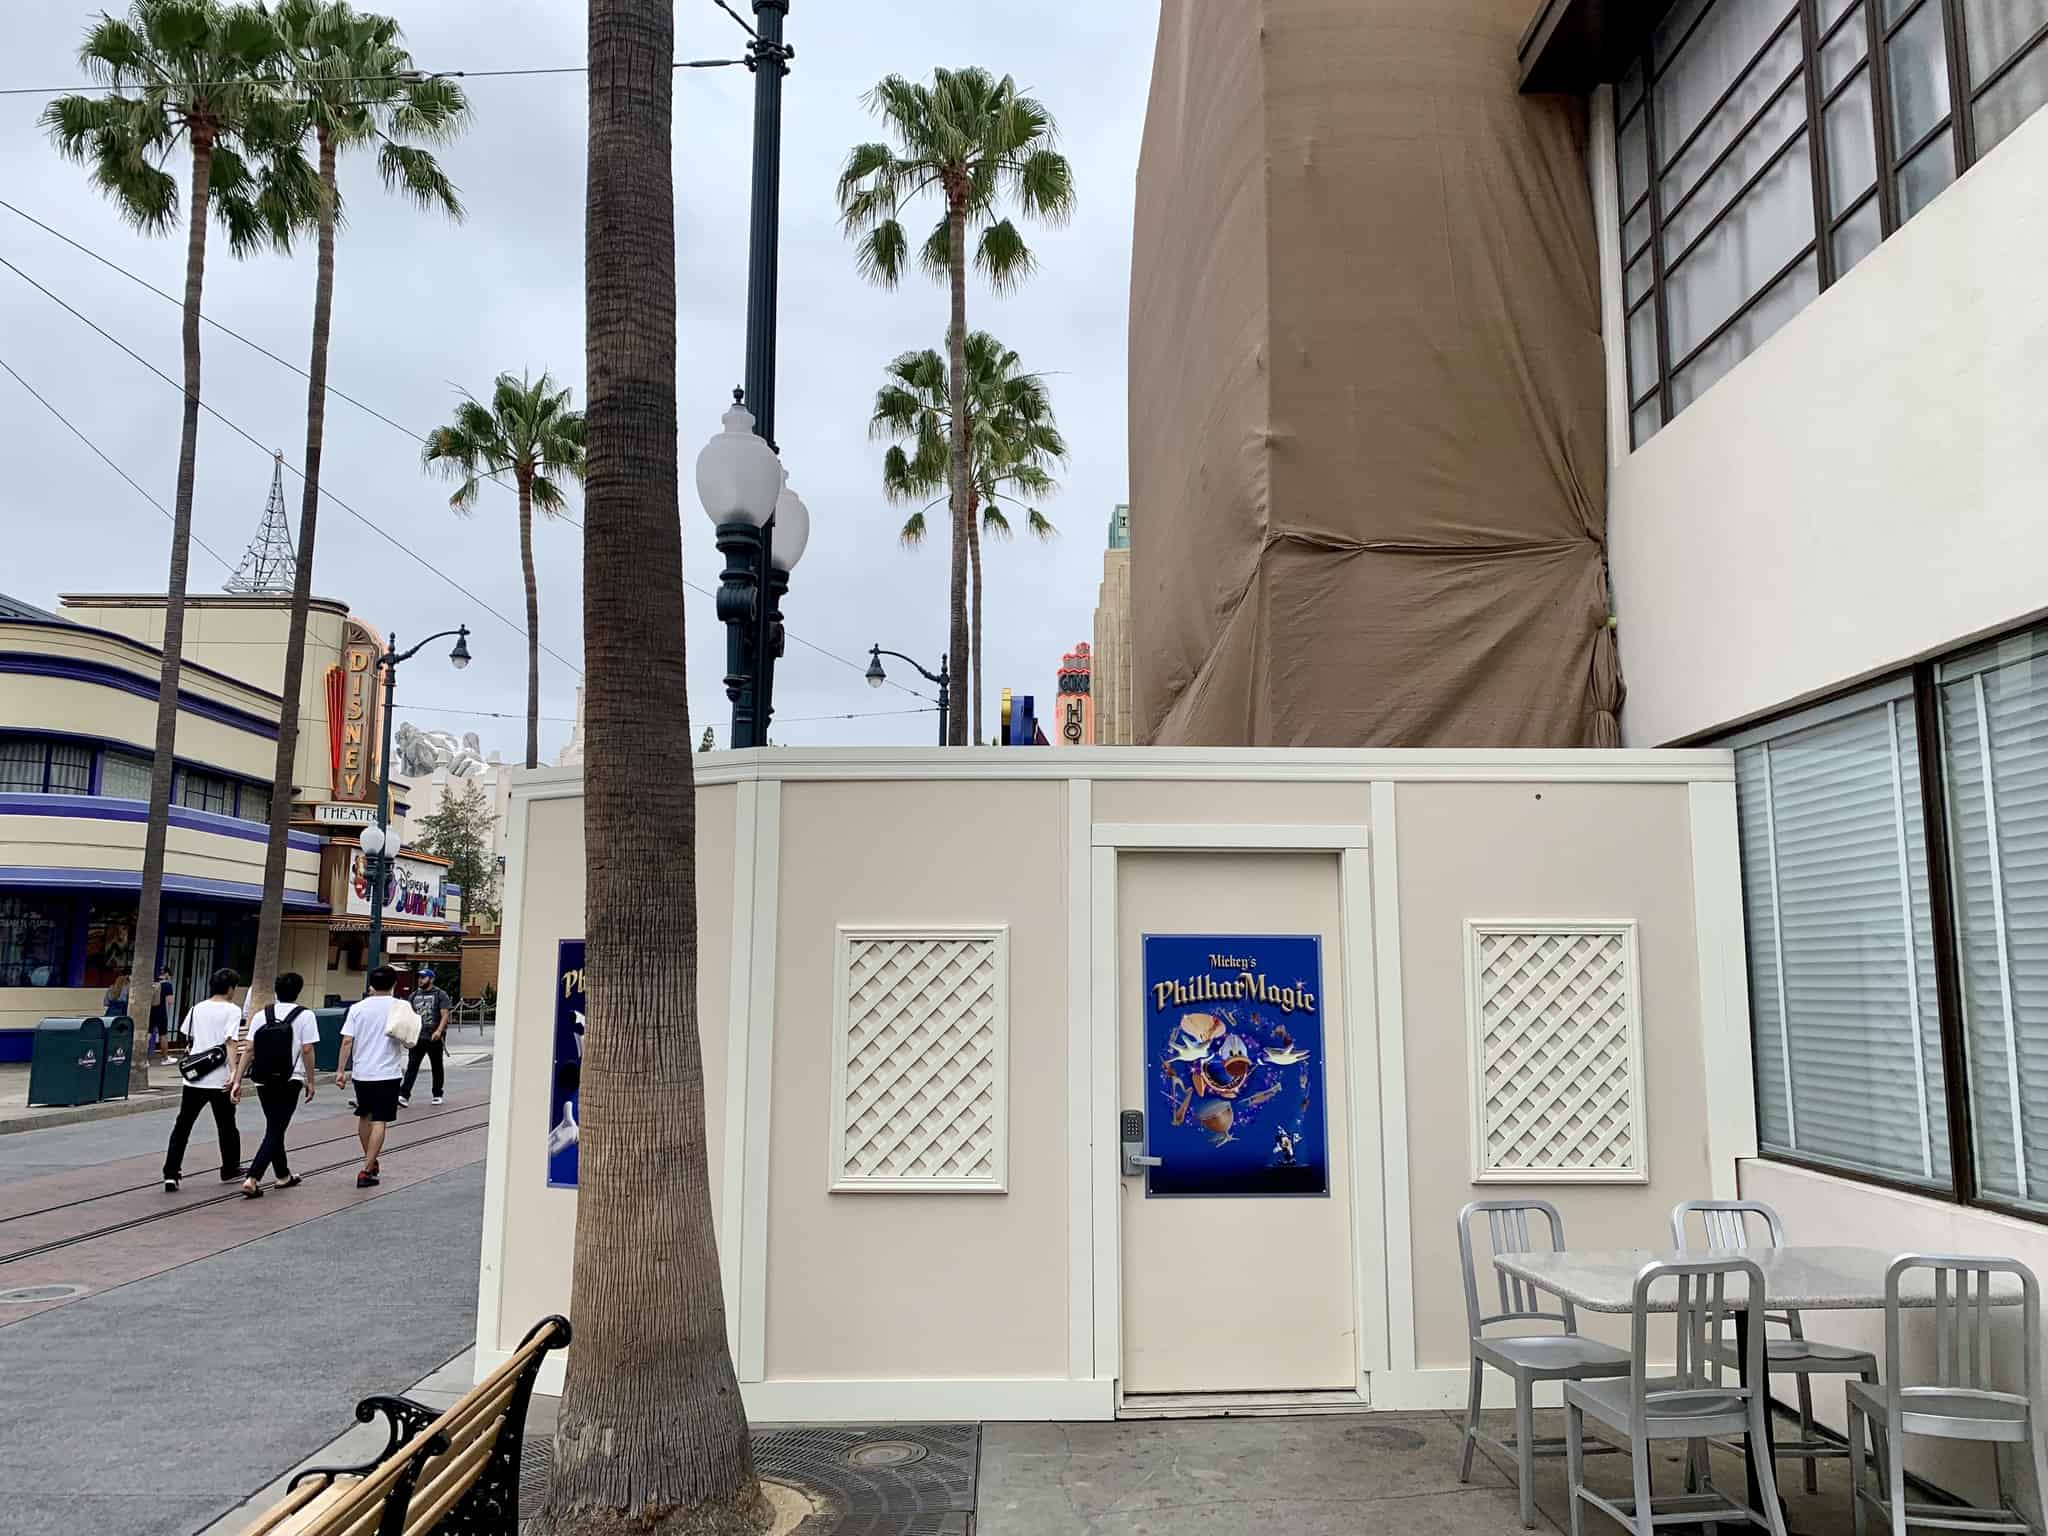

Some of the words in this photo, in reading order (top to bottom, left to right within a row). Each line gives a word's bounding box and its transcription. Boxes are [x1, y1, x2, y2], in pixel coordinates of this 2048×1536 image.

[344, 651, 368, 794] DISNEY
[1209, 954, 1257, 970] Mickey's
[1152, 972, 1316, 1012] PhilharMagic
